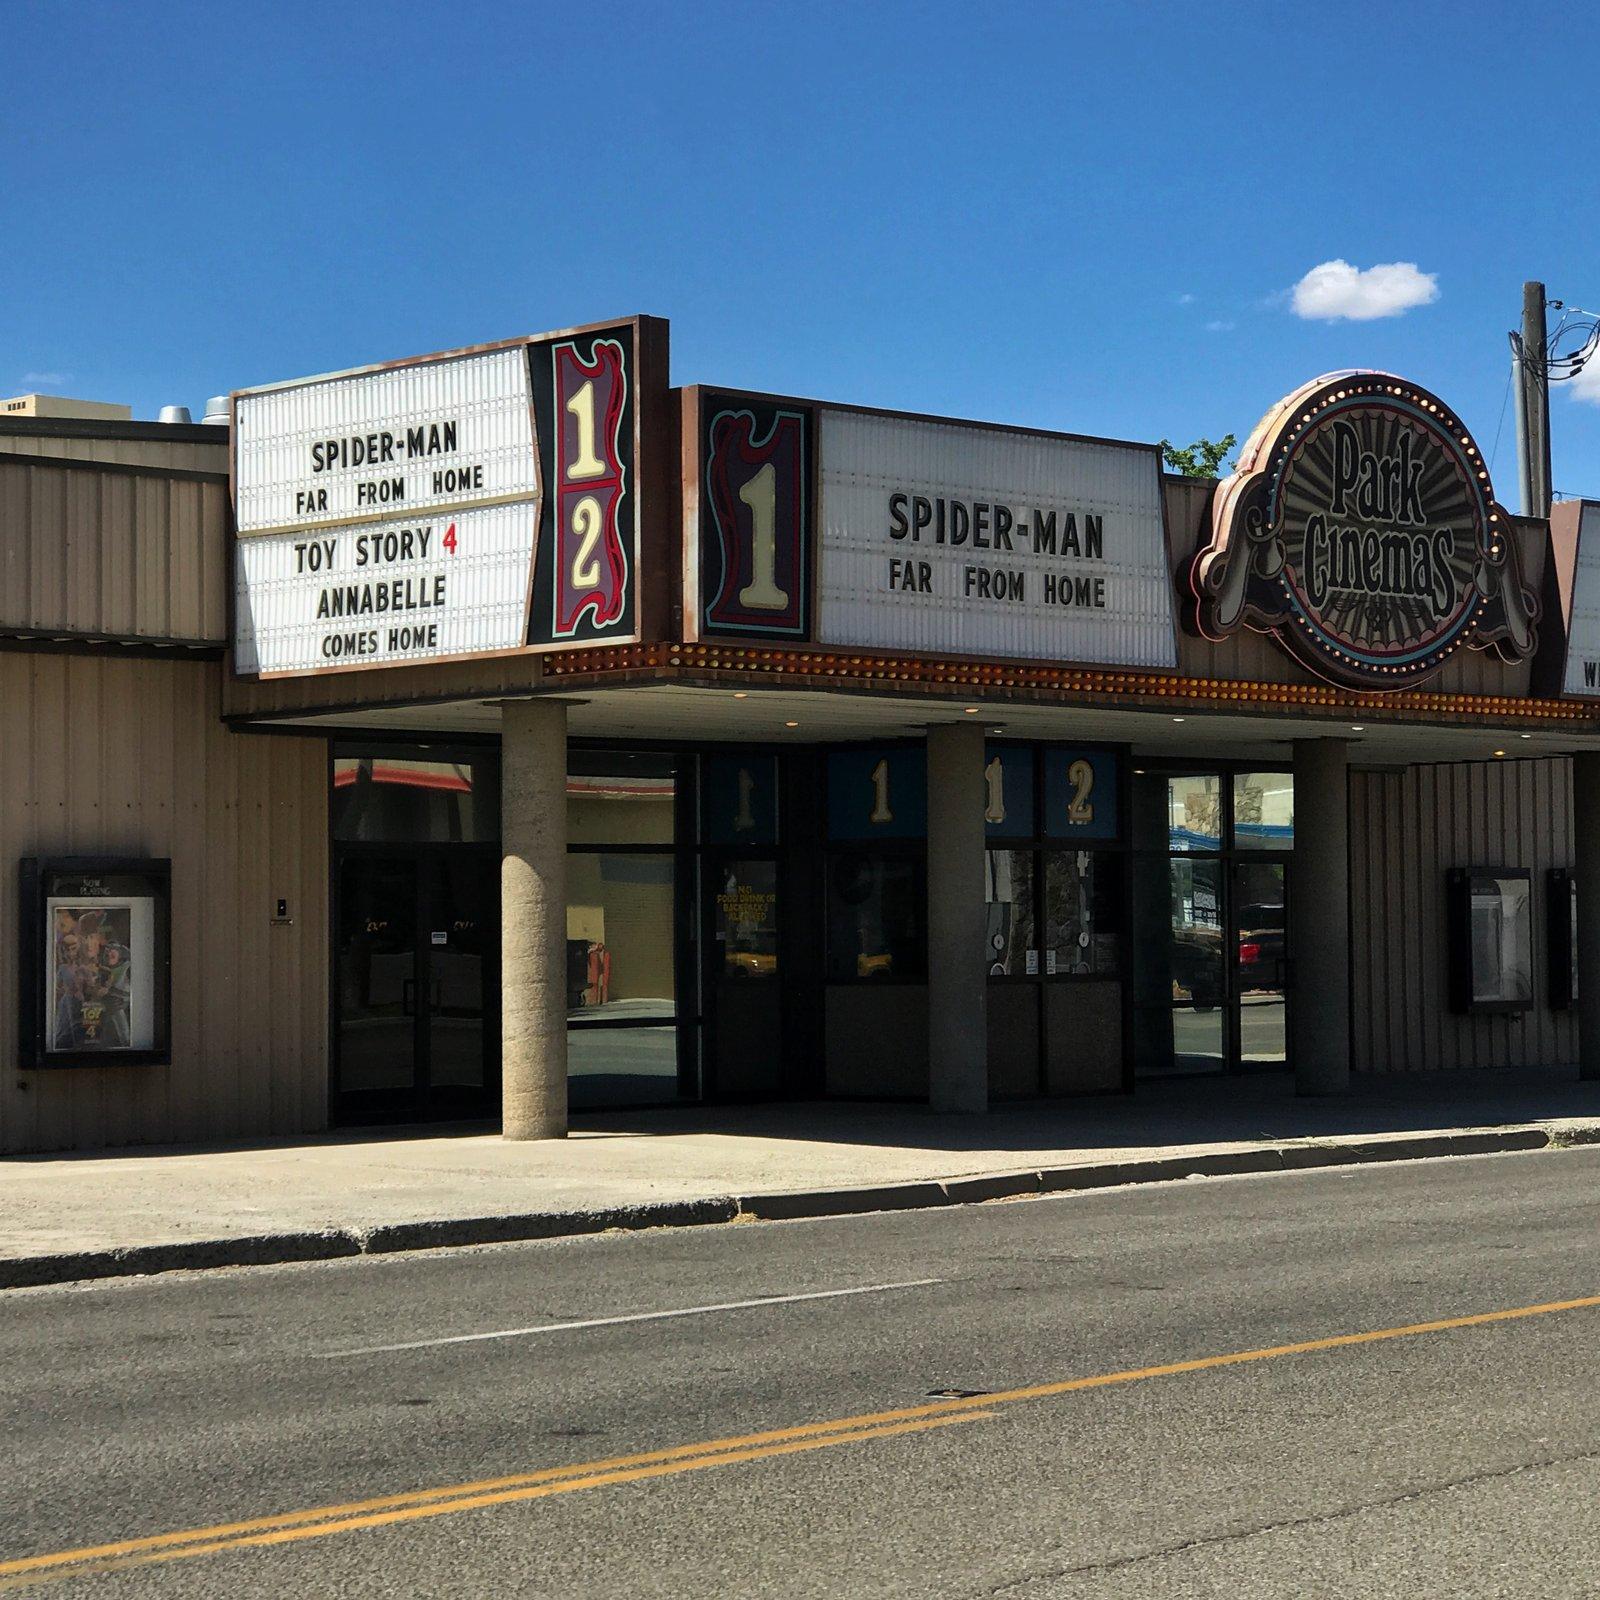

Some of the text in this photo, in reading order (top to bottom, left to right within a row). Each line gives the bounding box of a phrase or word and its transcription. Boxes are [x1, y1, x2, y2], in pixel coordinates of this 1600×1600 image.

[312, 421, 458, 473] SPIDER-MAN
[566, 381, 606, 479] 1
[295, 465, 484, 514] FAR FROM HOME
[1332, 420, 1427, 526] Park
[294, 523, 457, 572] TOY STORY 4
[572, 496, 602, 589] 2
[739, 462, 789, 610] 1
[889, 493, 1104, 559] SPIDER-MAN
[317, 575, 446, 619] ANNABELLE
[889, 559, 1105, 608] FAR FROM HOME
[1304, 514, 1455, 620] Cinemas
[322, 624, 437, 658] COMES HOME
[870, 758, 893, 824] 1
[1068, 760, 1094, 825] 2
[80, 1008, 103, 1020] TOY
